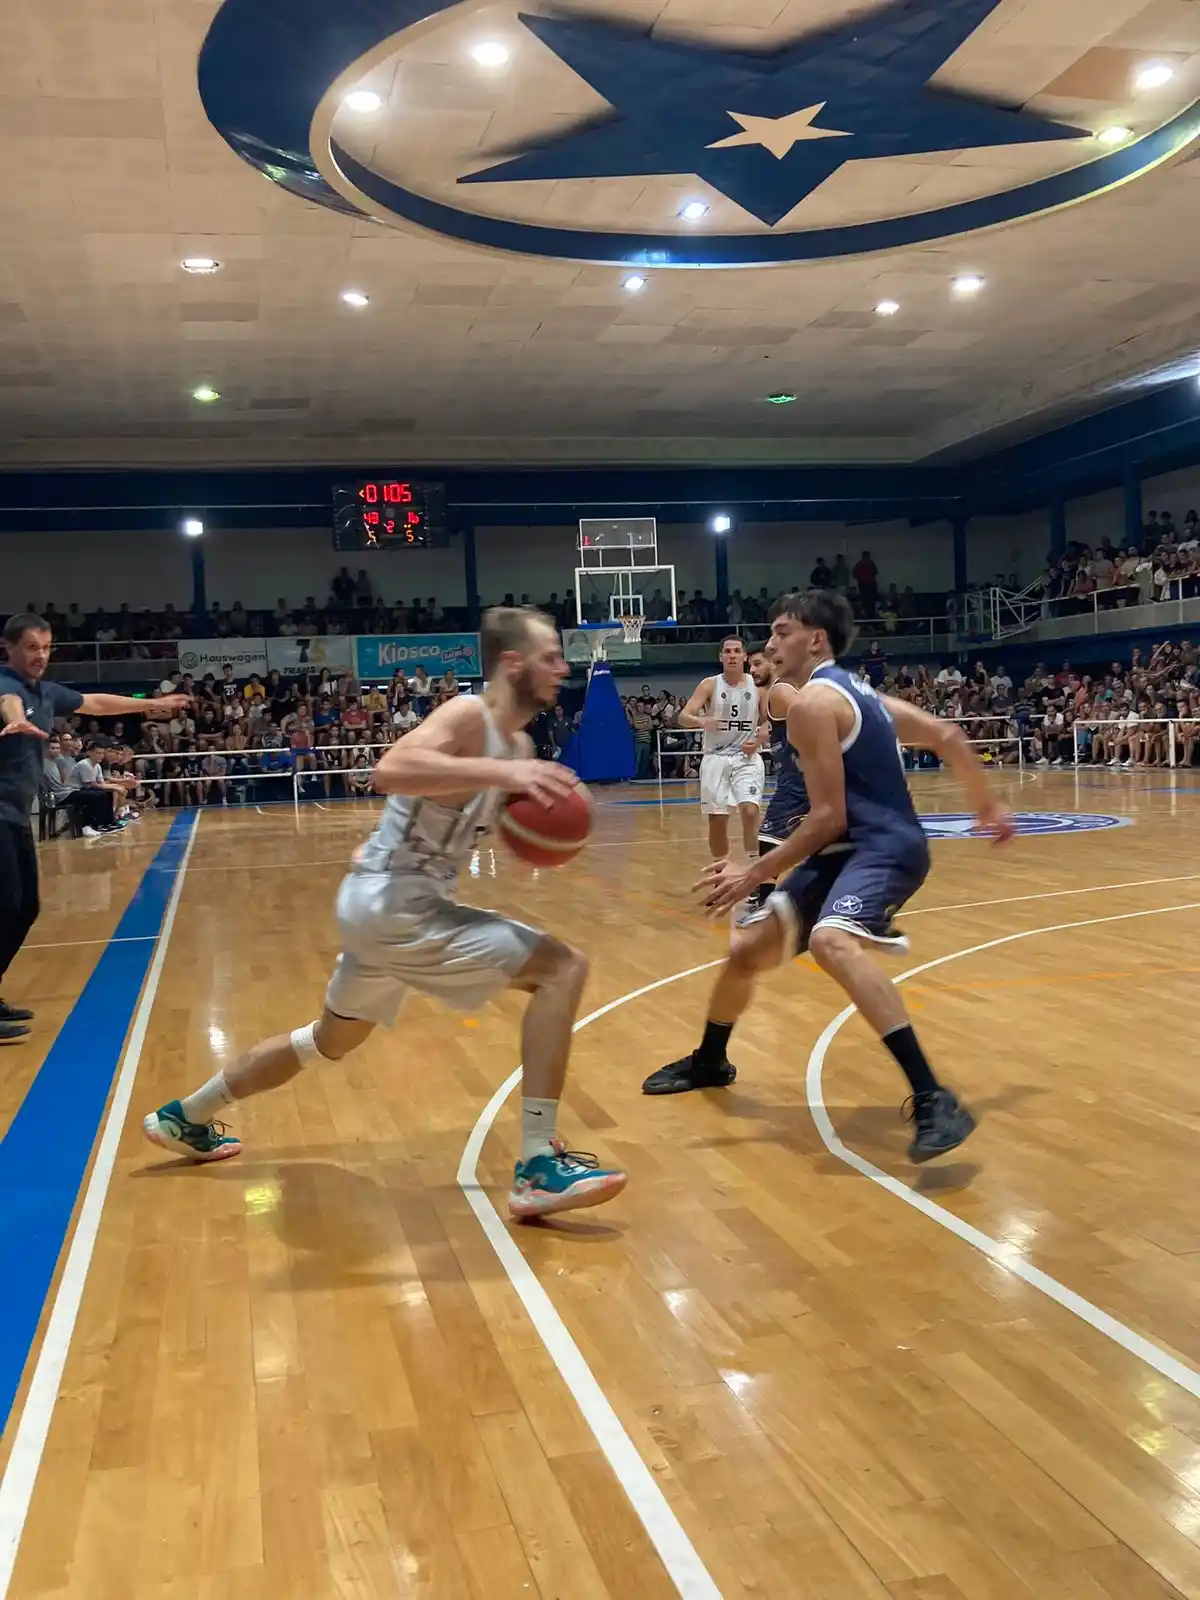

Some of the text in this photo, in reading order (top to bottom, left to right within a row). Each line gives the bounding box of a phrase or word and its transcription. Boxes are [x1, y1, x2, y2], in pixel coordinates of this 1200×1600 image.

[386, 520, 395, 533] 2
[405, 530, 414, 543] 5
[199, 653, 266, 664] Hauswagen
[378, 642, 440, 667] Kiosco
[730, 704, 739, 718] 5
